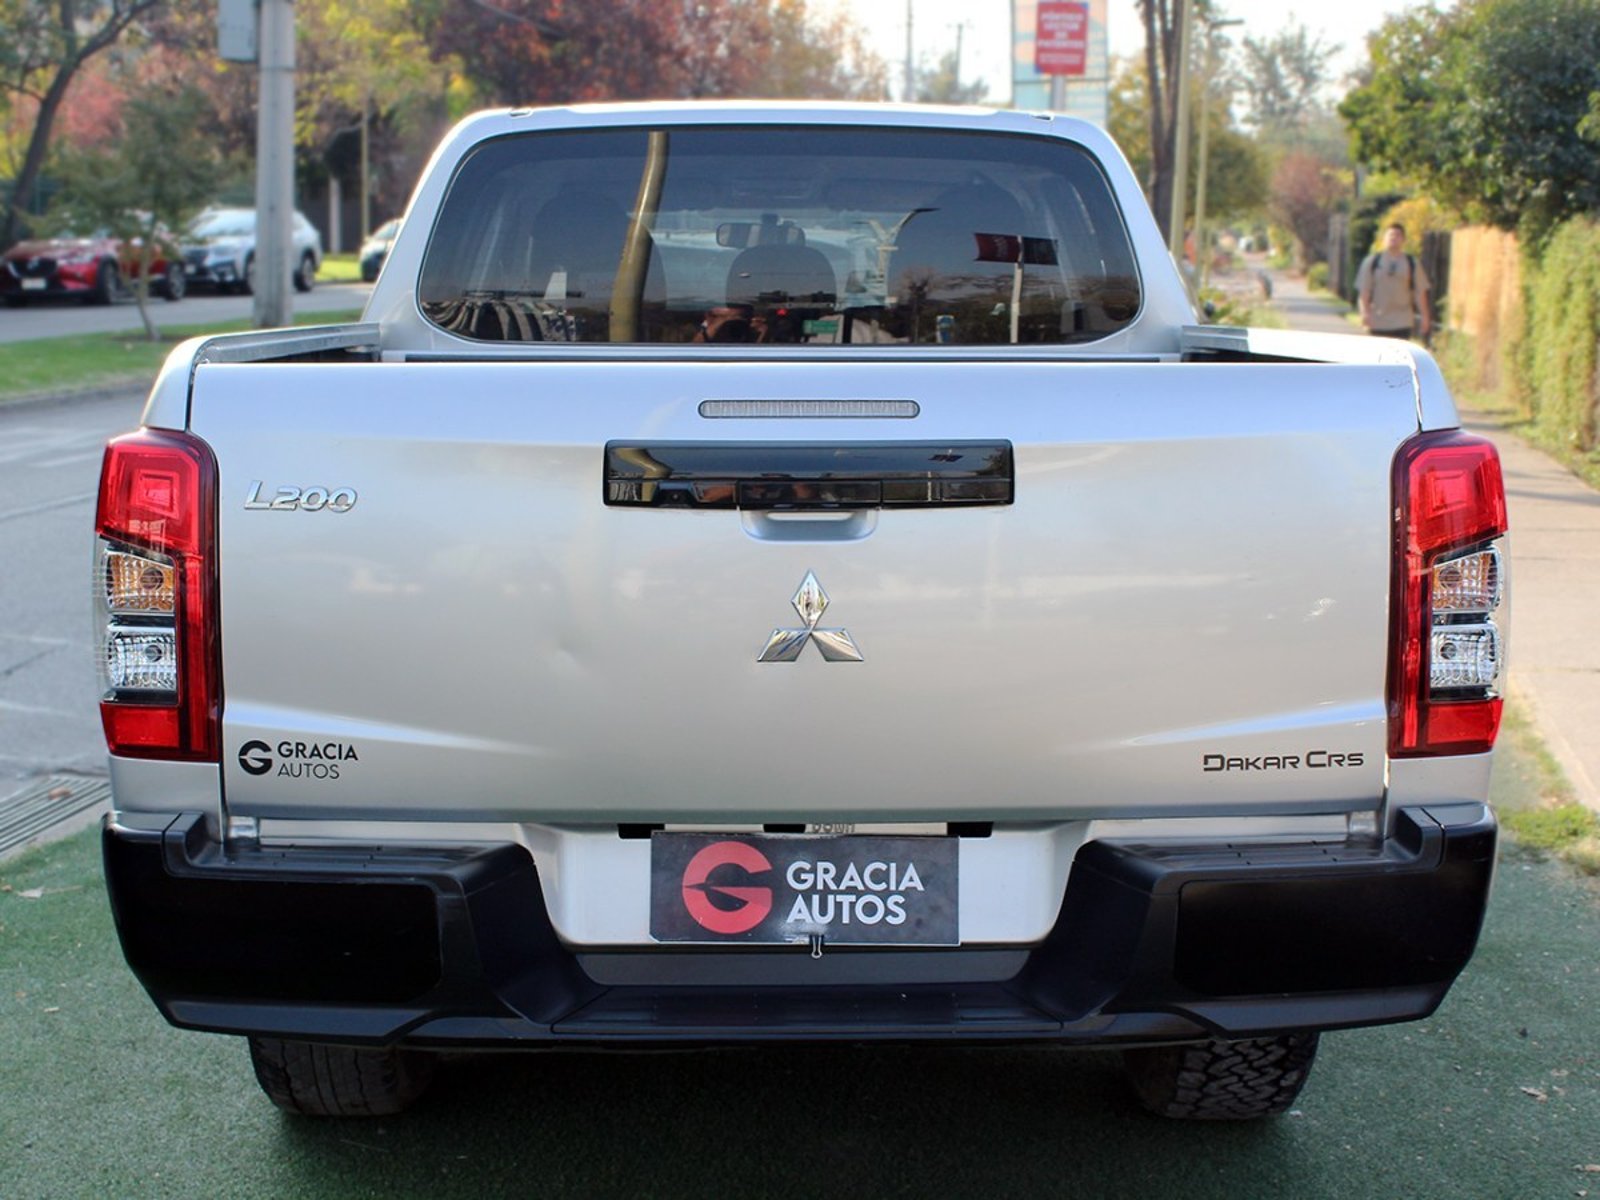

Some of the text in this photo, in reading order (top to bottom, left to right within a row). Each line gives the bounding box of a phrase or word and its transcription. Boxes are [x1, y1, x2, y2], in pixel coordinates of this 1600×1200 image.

[244, 480, 358, 513] L200
[277, 741, 359, 760] GRACIA
[277, 762, 340, 779] AUTOS
[786, 861, 924, 891] GRACIA
[786, 894, 906, 924] AUTOS
